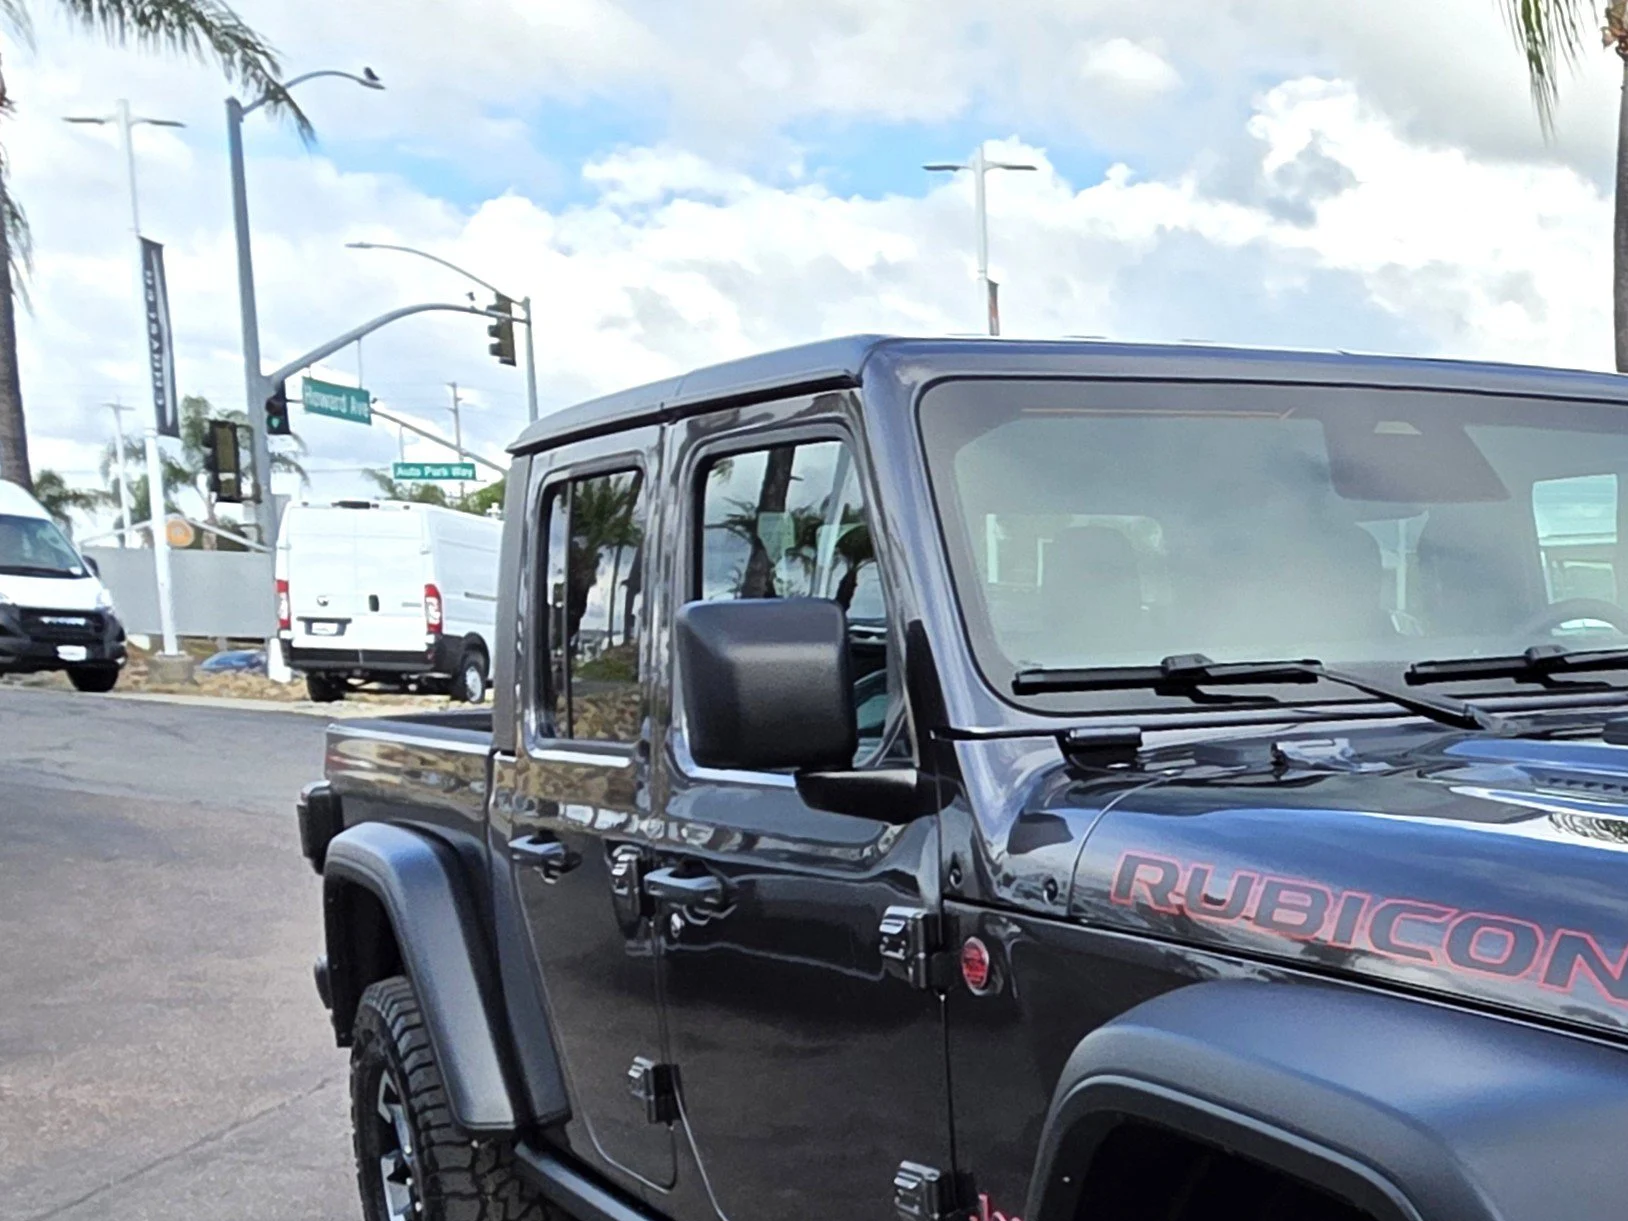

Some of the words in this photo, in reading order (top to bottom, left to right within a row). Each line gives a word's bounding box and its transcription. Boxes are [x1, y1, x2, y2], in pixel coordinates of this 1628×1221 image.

[396, 466, 421, 477] Auto
[423, 465, 449, 477] Park
[451, 466, 473, 479] Way
